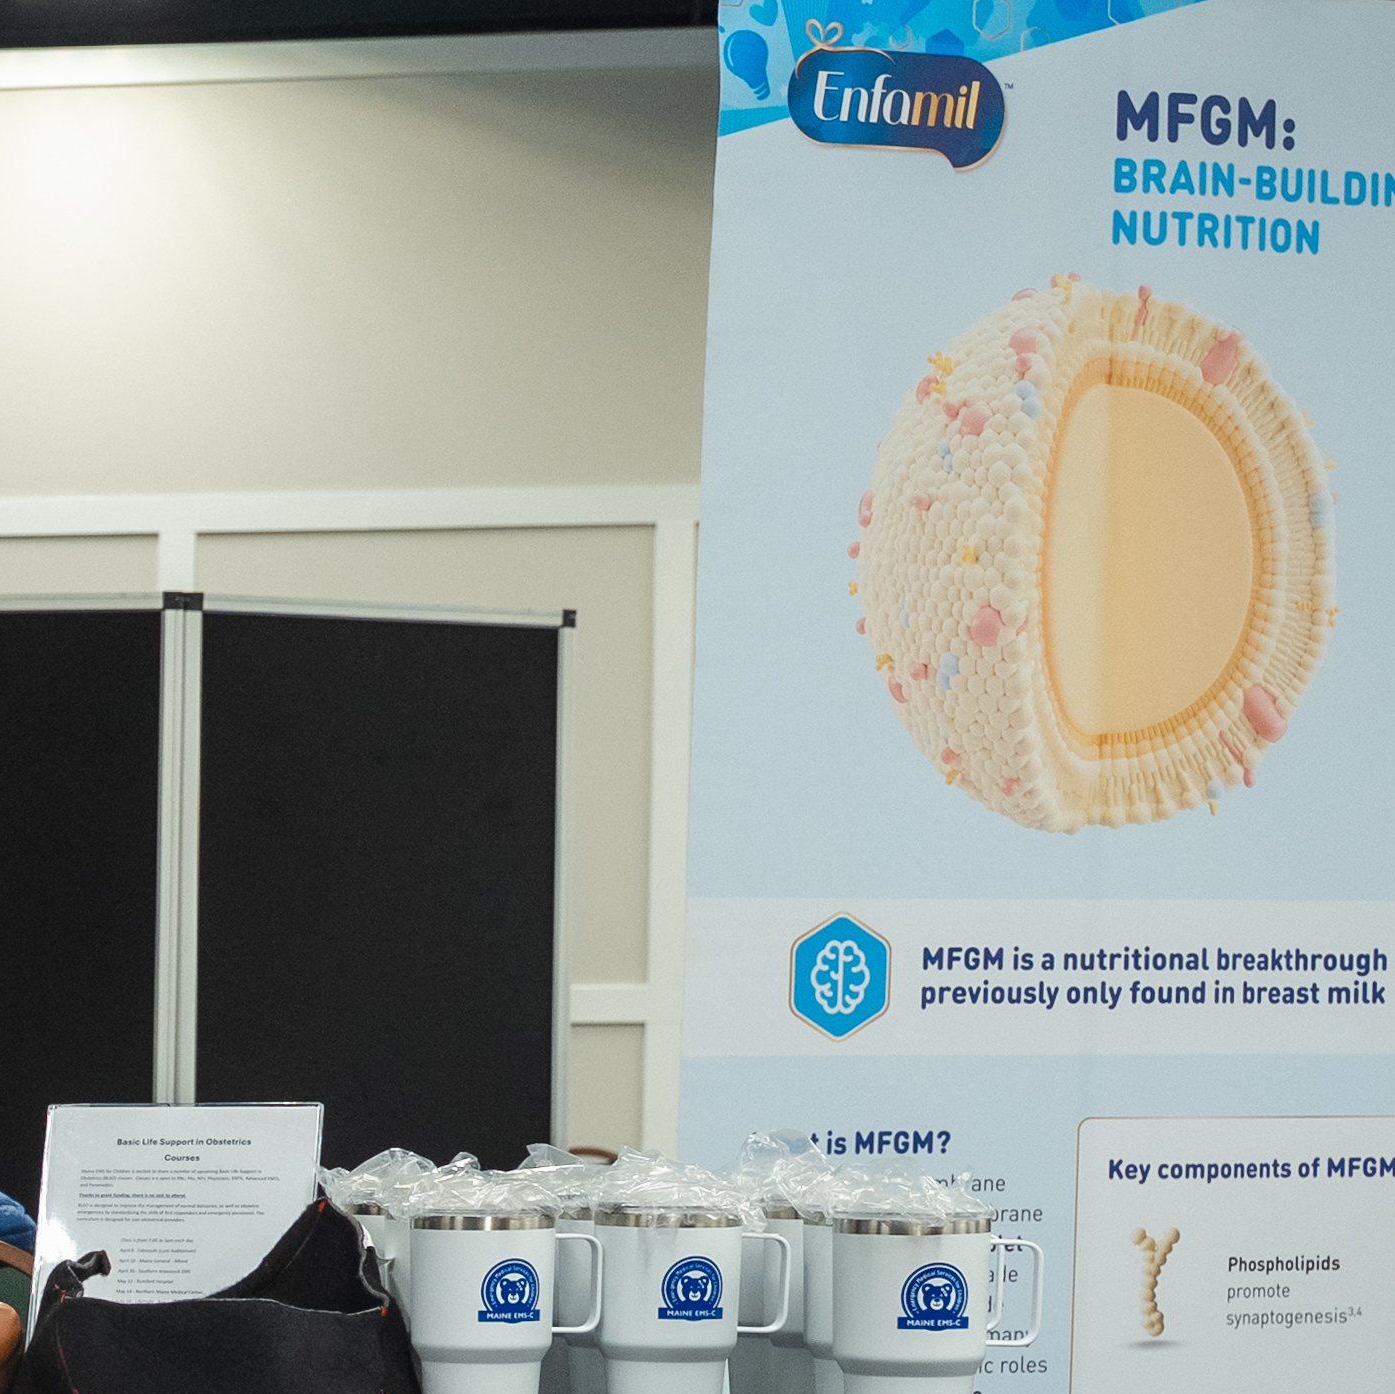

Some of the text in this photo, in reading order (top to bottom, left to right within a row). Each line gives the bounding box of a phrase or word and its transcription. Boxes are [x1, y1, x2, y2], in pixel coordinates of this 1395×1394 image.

[812, 69, 981, 130] Enfamil
[1116, 89, 1296, 152] MFGM:
[1112, 209, 1320, 256] NUTRITION
[922, 945, 1388, 977] MFGM is a nutritional breakthrough
[921, 979, 1386, 1010] previously only found in breast milk
[116, 1138, 252, 1147] Basic Life Support in Obstetrics
[826, 1129, 848, 1155] is
[854, 1129, 952, 1155] MFGM?
[164, 1153, 200, 1162] Courses
[1108, 1156, 1395, 1184] Key components of MFGM
[1227, 1255, 1341, 1275] Phospholipids
[1226, 1283, 1291, 1303] promote
[486, 1311, 535, 1320] MAINE EMS-C
[666, 1309, 717, 1317] MAINE EMS-C
[906, 1319, 961, 1327] MAINE EMS-C
[1000, 1355, 1048, 1374] roles
